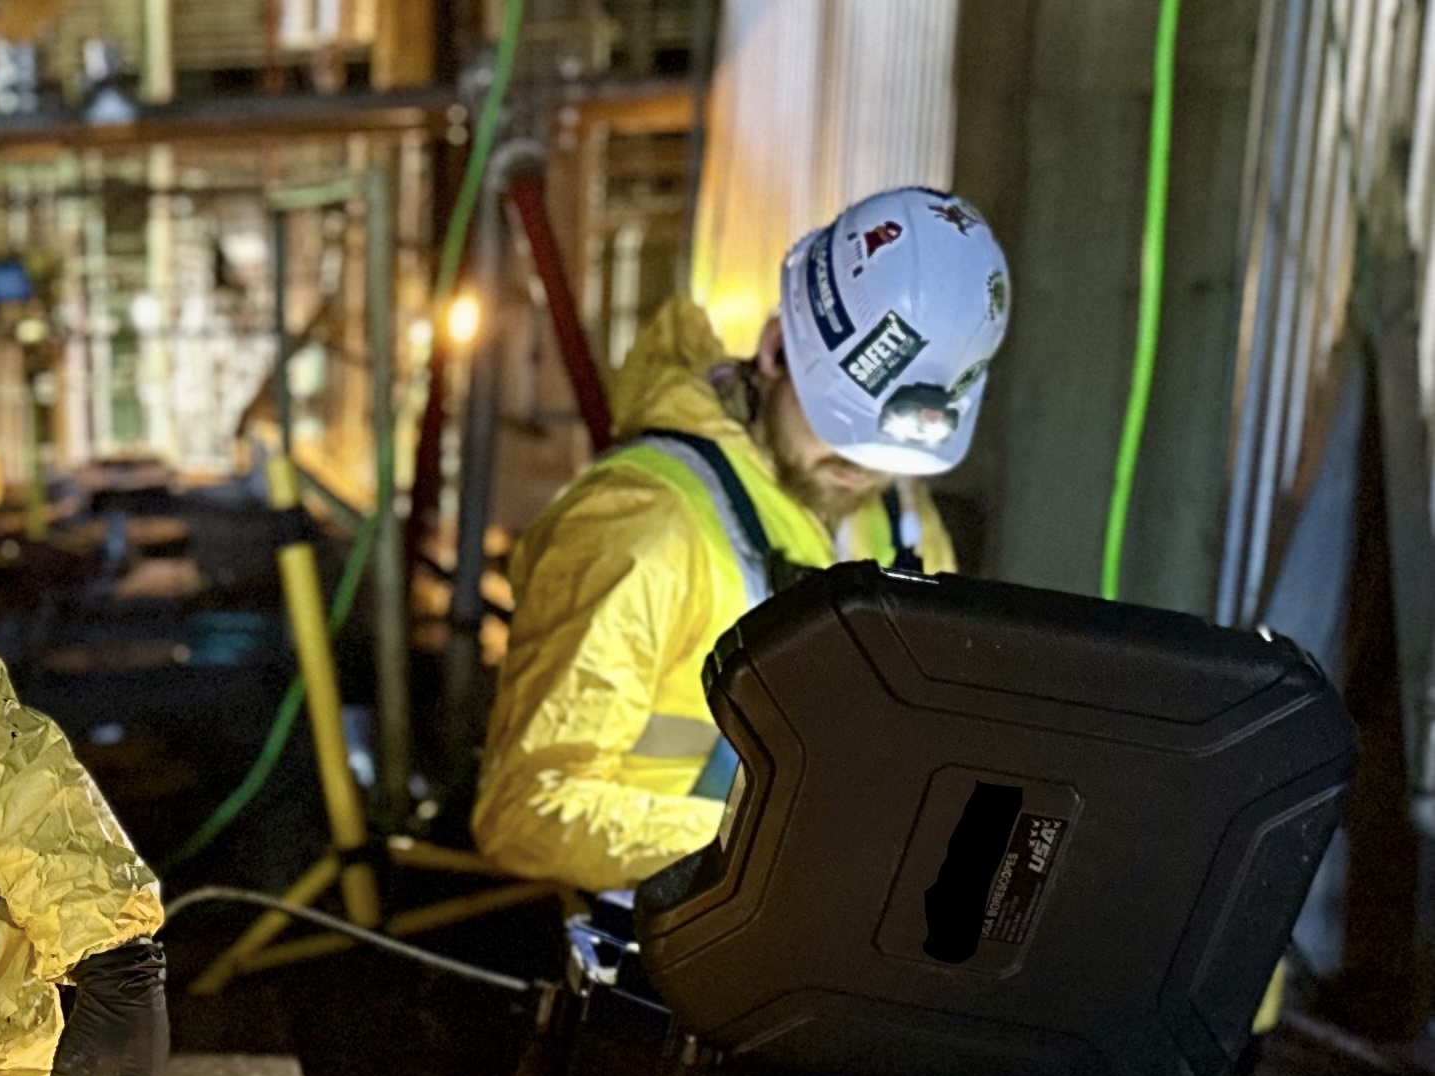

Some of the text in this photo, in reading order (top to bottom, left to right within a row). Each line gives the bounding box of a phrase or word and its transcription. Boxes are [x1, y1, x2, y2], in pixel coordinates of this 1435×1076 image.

[848, 321, 907, 382] SAFETY
[1027, 825, 1057, 873] USA
[986, 852, 1019, 916] BORESCOPES
[979, 919, 995, 938] USA
